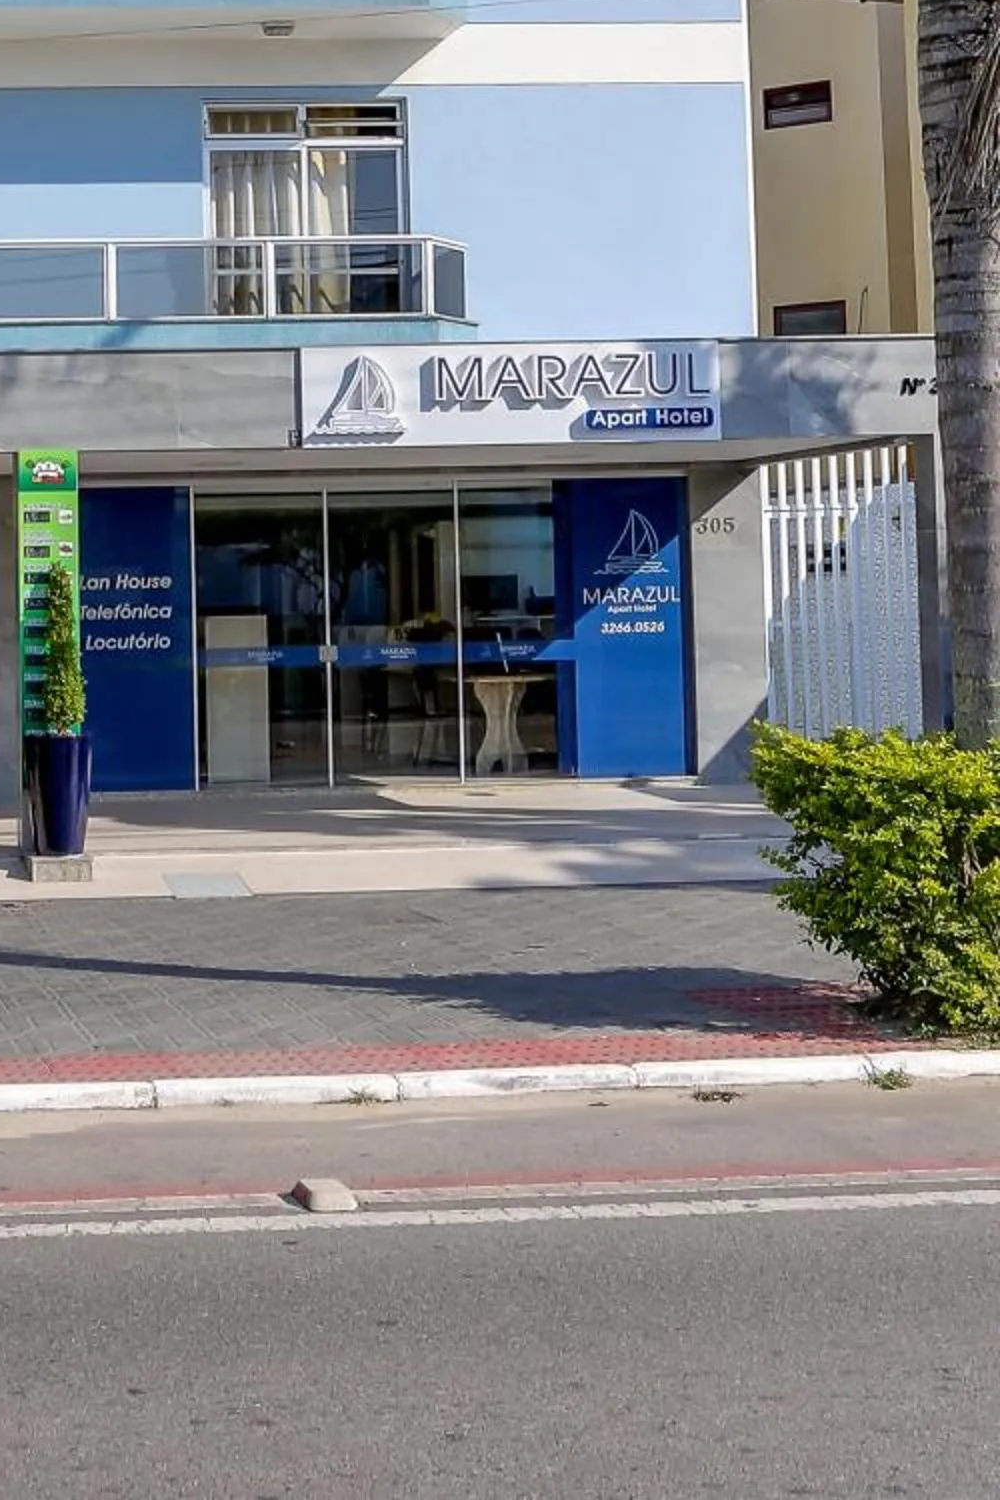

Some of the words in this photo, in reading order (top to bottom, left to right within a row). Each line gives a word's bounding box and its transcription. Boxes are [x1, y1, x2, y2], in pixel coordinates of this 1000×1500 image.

[434, 352, 712, 399] MARAZUL
[591, 409, 647, 429] Apart
[655, 407, 709, 425] Hotel
[694, 517, 735, 534] 305
[80, 574, 111, 591] Lan
[116, 573, 173, 589] House
[583, 585, 681, 605] MARAZUL
[80, 602, 173, 620] Telefônica
[607, 606, 632, 615] Apart
[633, 603, 657, 613] Hotel
[600, 620, 665, 635] 3266.0526
[85, 631, 172, 651] Locutório
